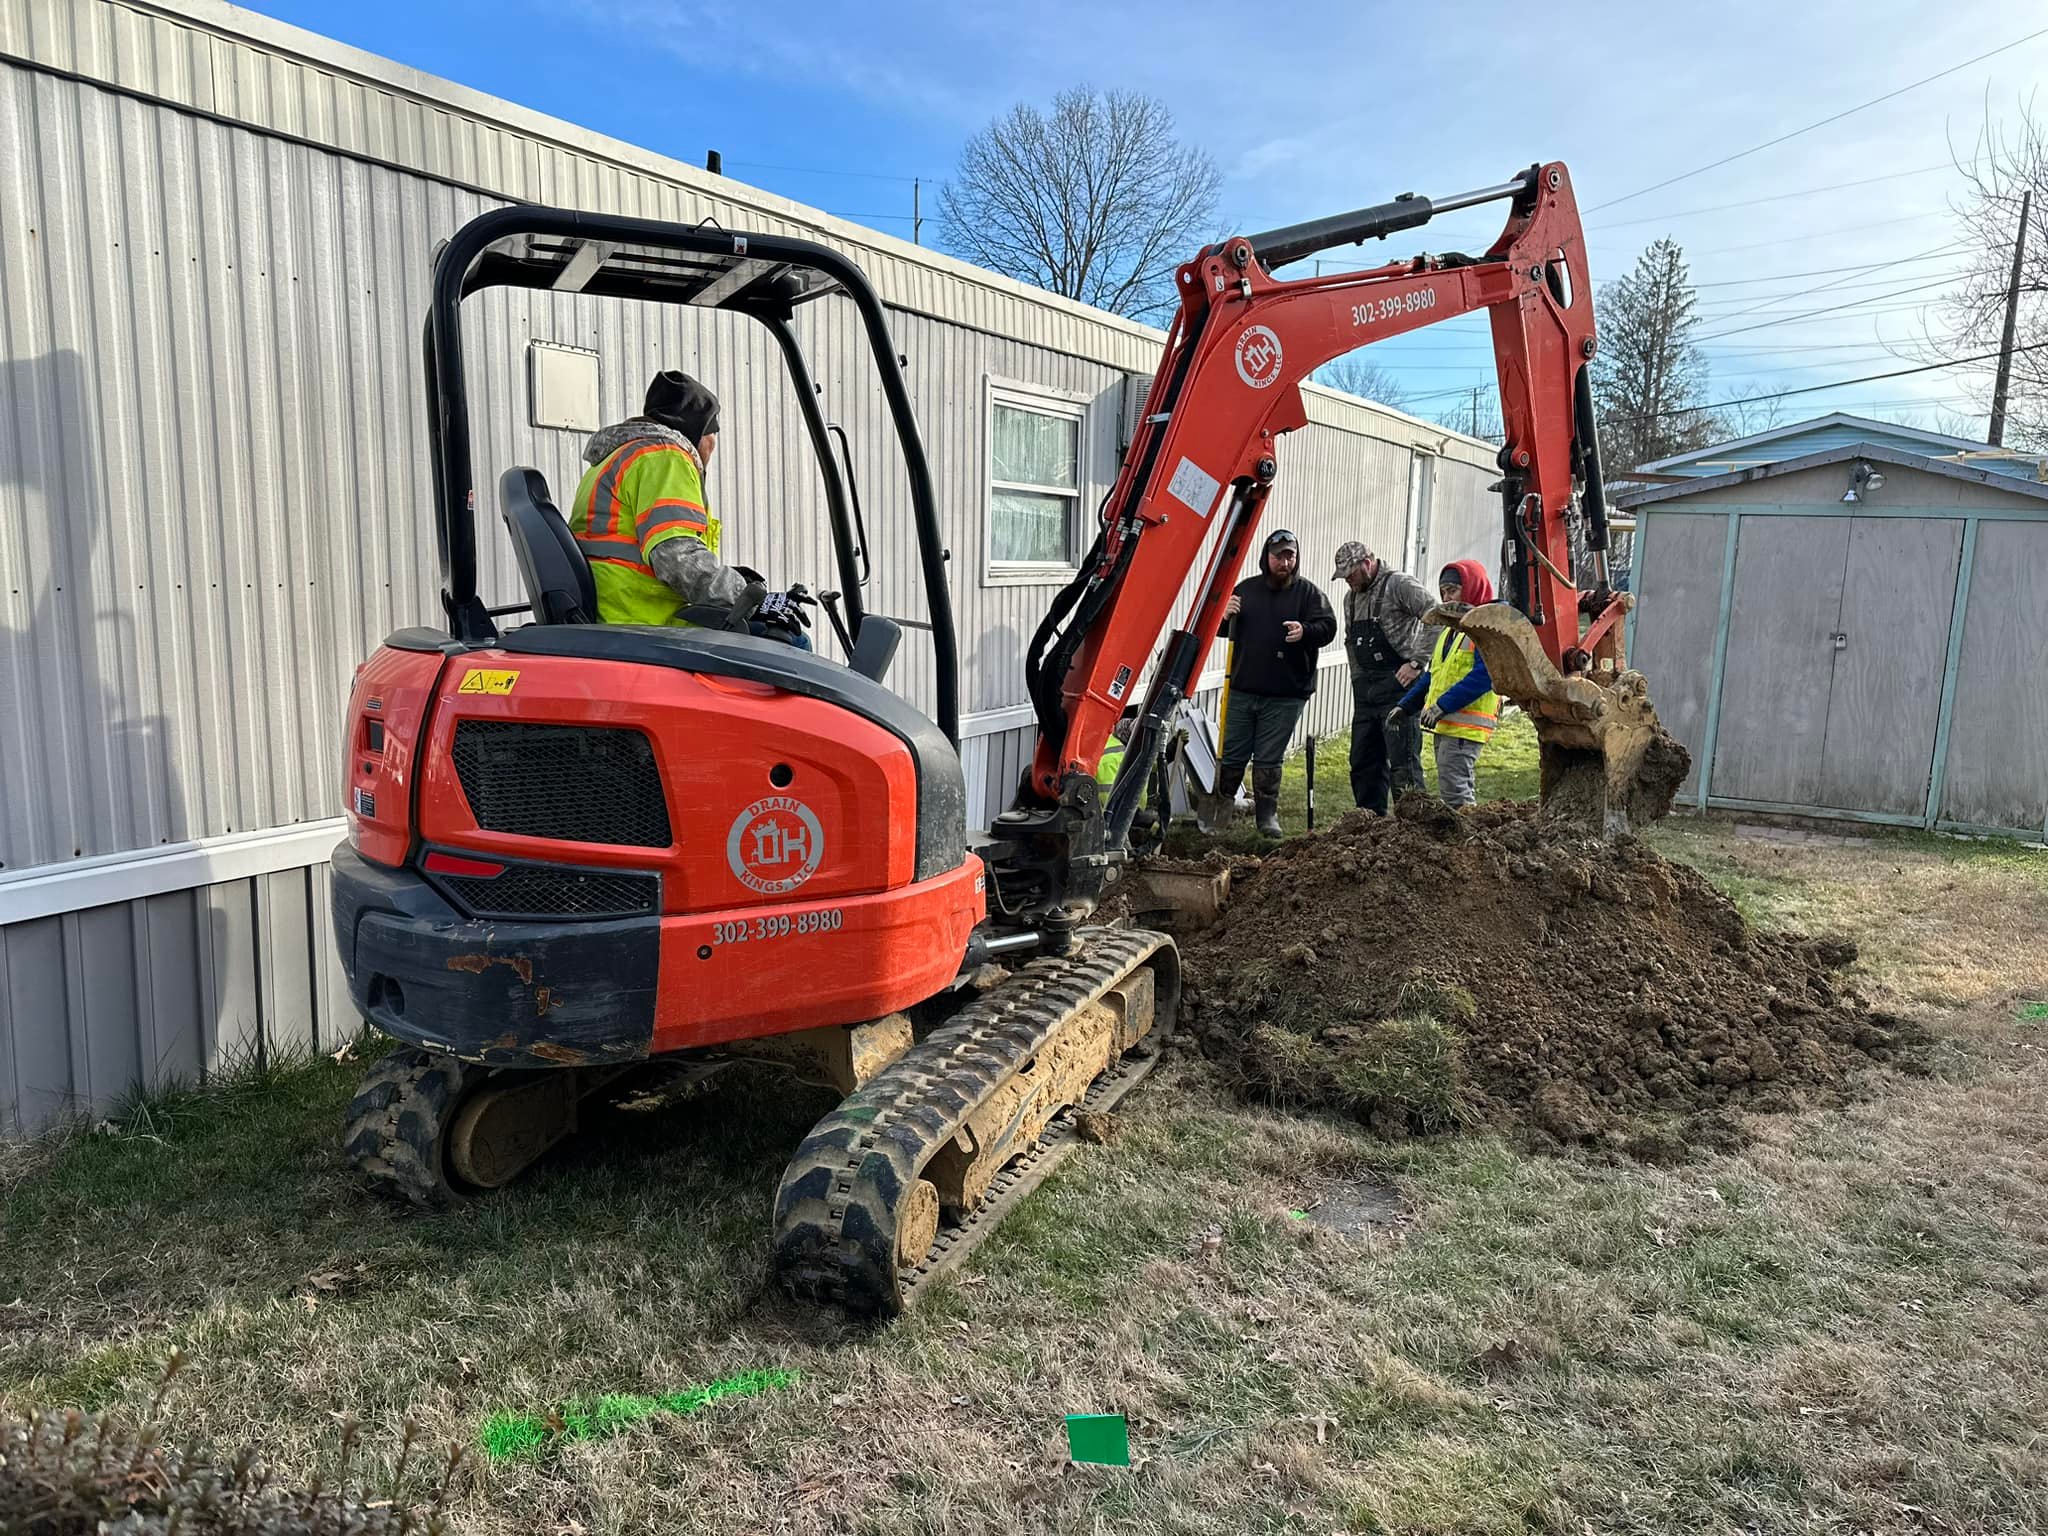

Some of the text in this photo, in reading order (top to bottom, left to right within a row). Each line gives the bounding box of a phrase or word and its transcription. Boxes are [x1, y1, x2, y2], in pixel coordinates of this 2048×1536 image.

[1351, 287, 1436, 327] 302-399-8980
[1236, 326, 1257, 351] DRAIN
[747, 798, 802, 817] DRAIN
[790, 863, 814, 886] LLC
[712, 908, 843, 946] 302-399-8980
